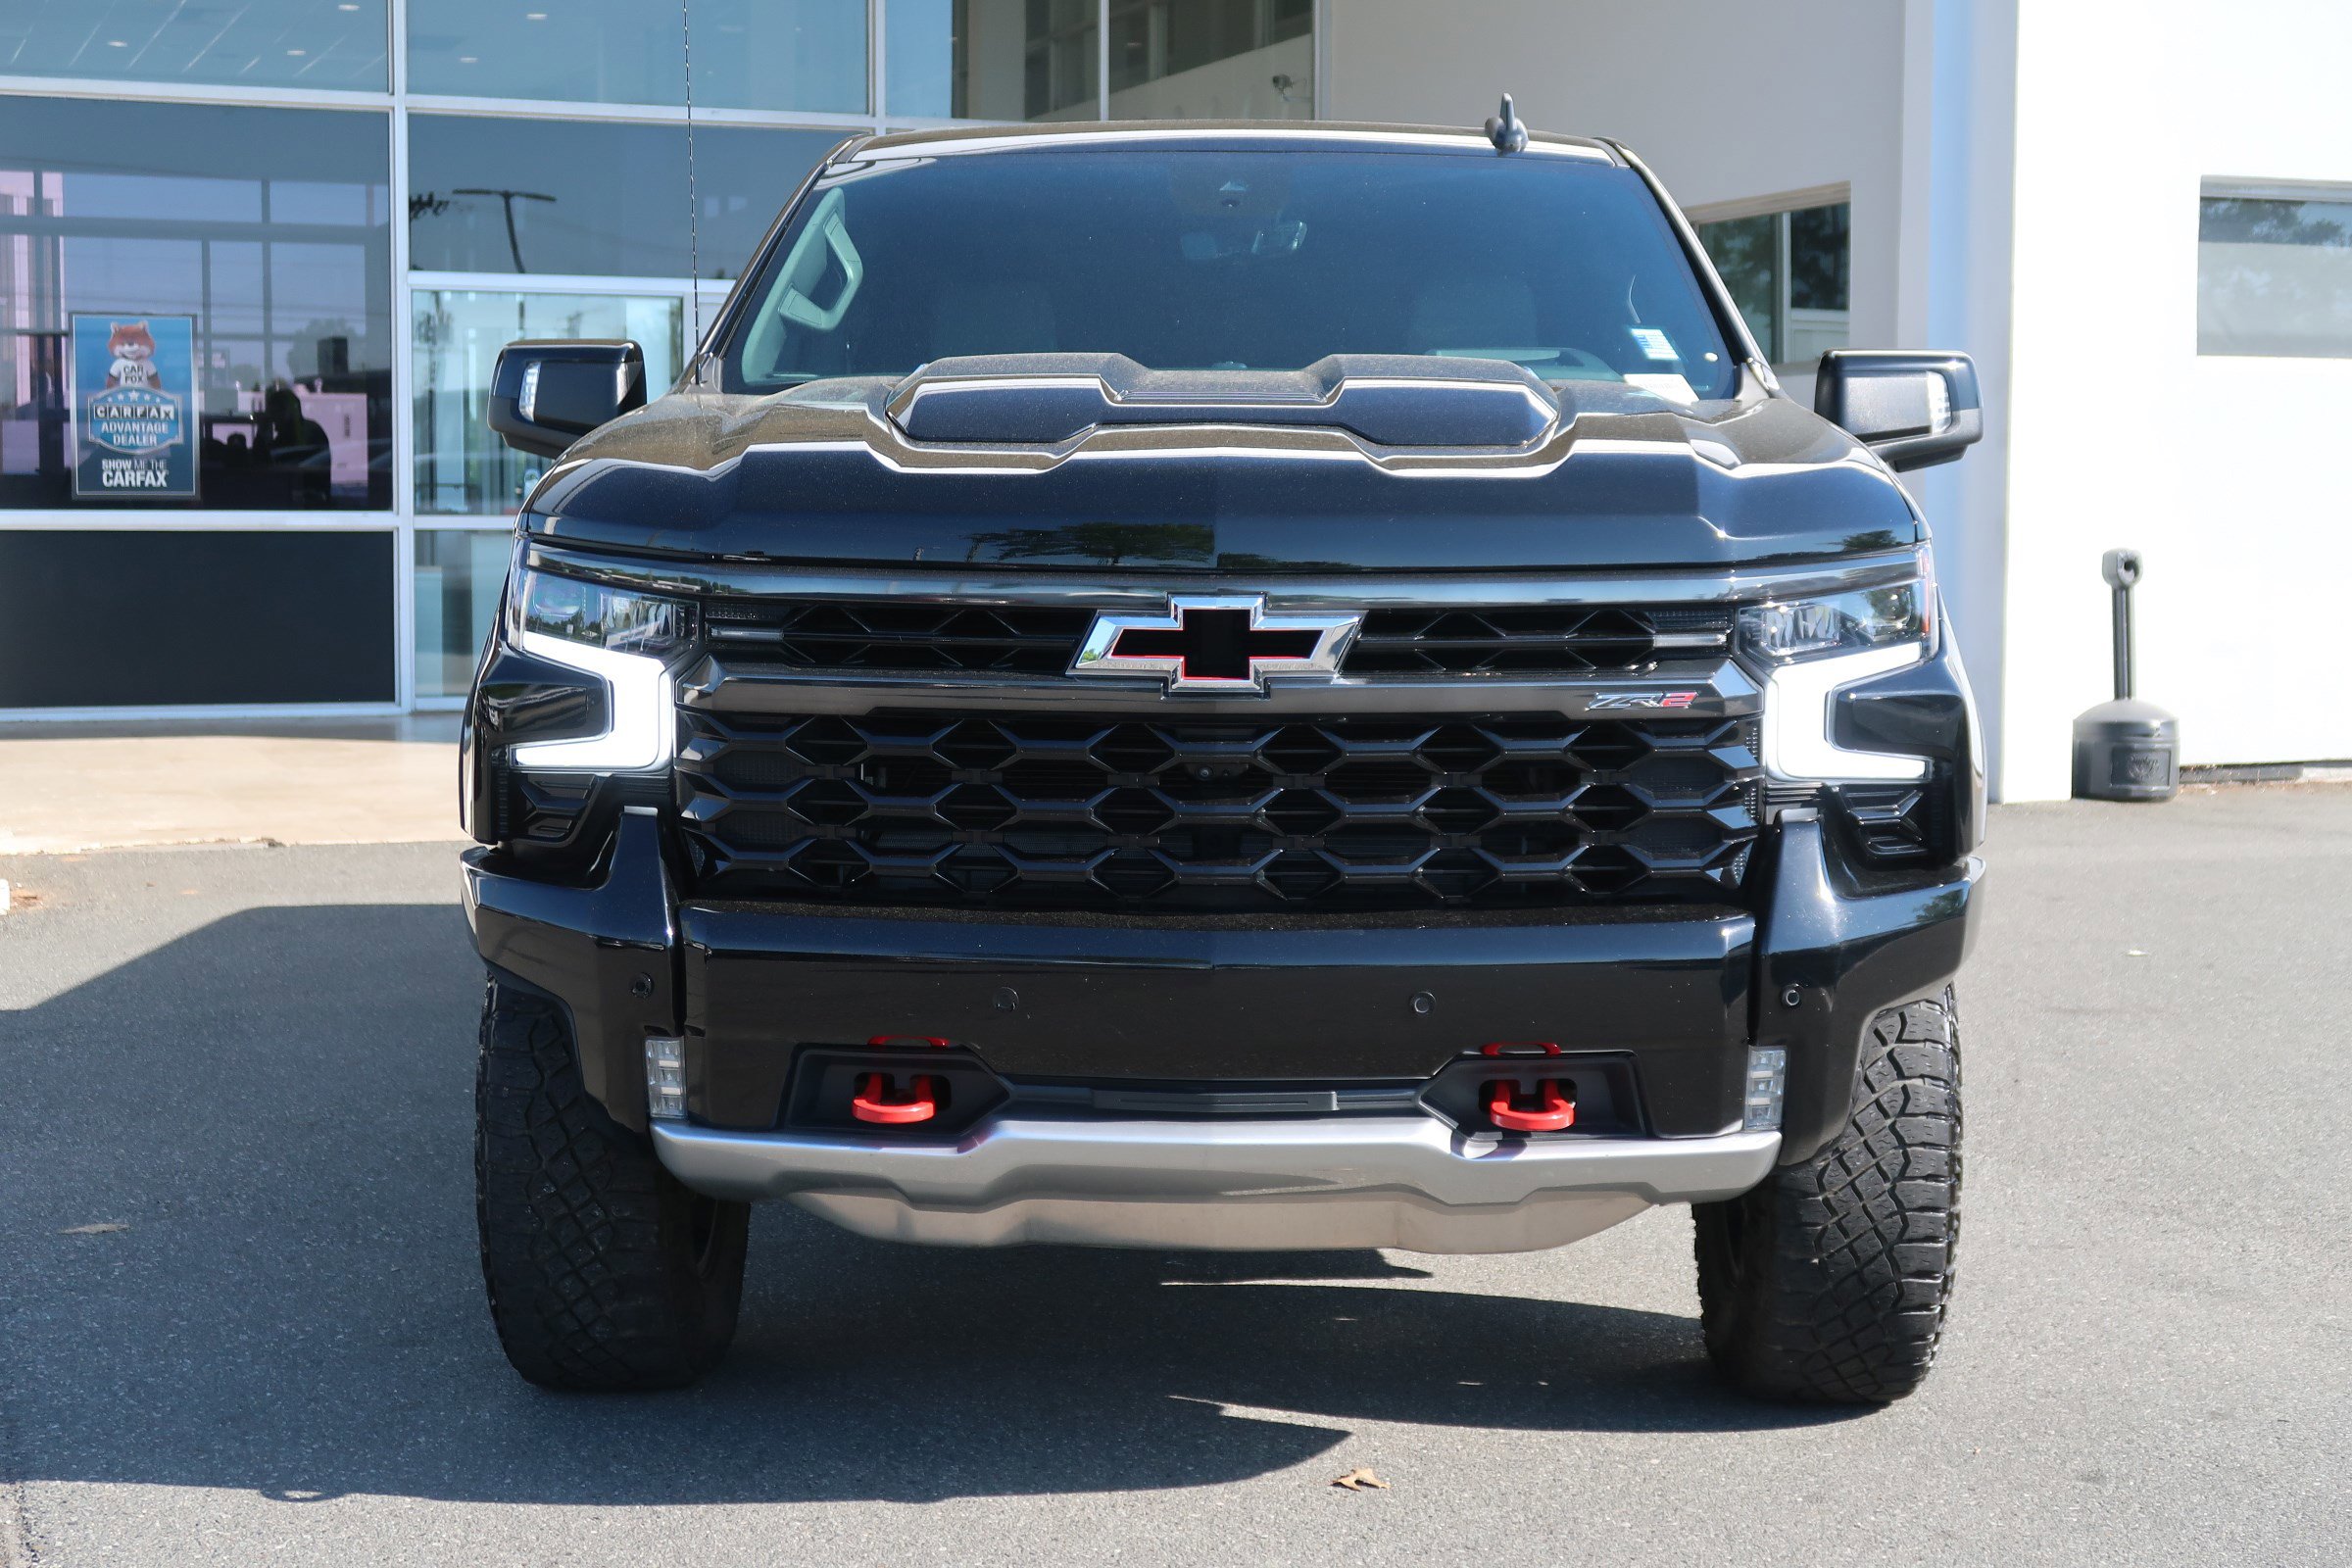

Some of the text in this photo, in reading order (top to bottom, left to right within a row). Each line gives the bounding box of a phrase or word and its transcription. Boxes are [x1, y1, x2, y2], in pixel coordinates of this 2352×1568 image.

[123, 367, 144, 376] CAR
[124, 376, 144, 385] FOX
[96, 406, 172, 419] CARFAX
[101, 421, 169, 434] ADVANTAGE
[113, 434, 158, 446] DEALER
[102, 459, 168, 470] SHOW ME THE
[102, 470, 168, 487] CARFAX
[1585, 691, 1699, 710] ZR2
